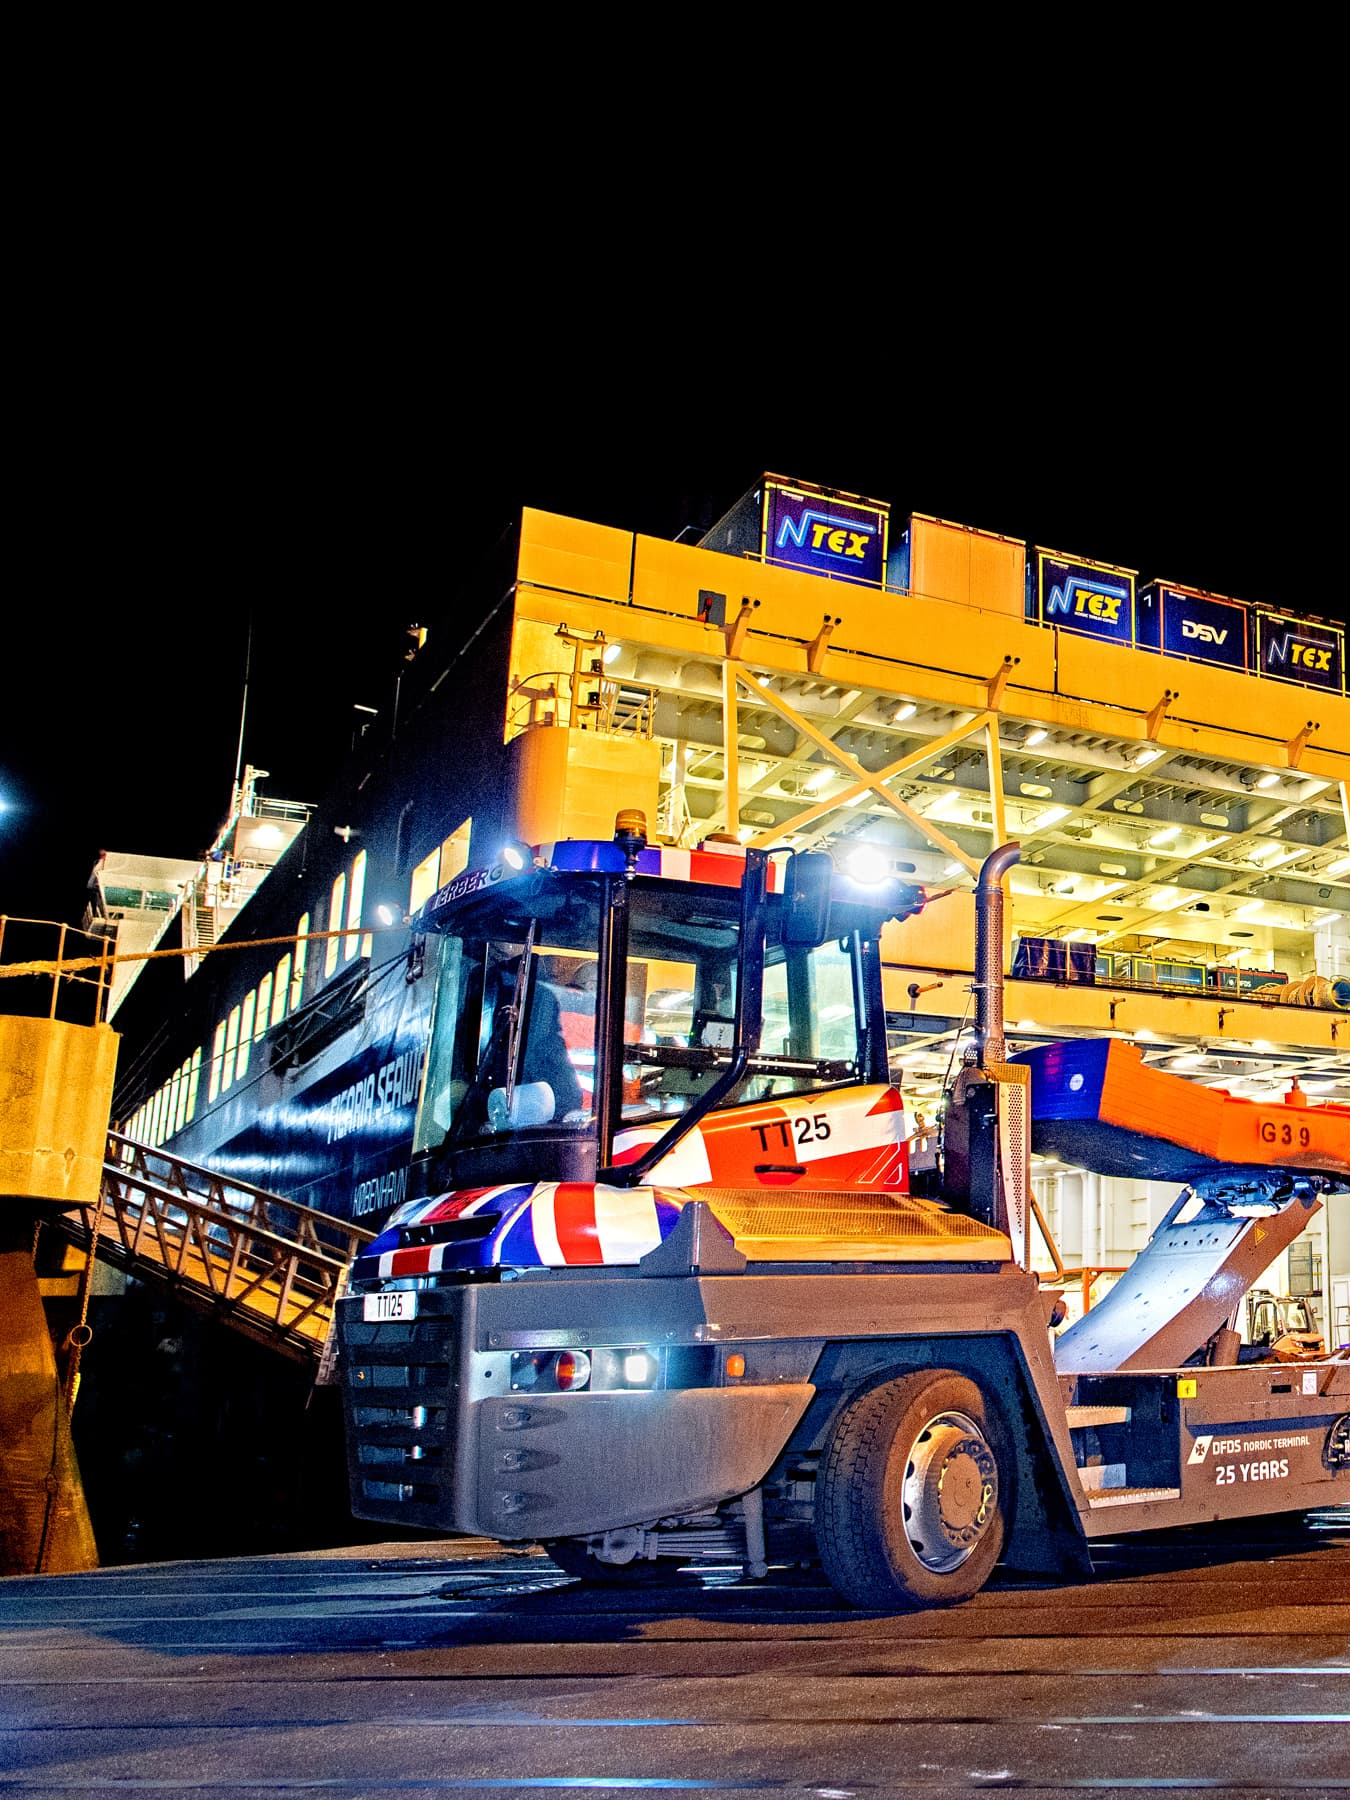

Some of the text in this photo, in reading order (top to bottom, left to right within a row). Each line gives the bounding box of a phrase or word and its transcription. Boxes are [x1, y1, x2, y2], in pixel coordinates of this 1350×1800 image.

[1181, 619, 1228, 645] DSV
[751, 1112, 832, 1152] TT25
[1212, 1439, 1241, 1456] DFDS
[1273, 1435, 1310, 1449] TERMINAL
[1215, 1458, 1289, 1486] 25 YEARS
